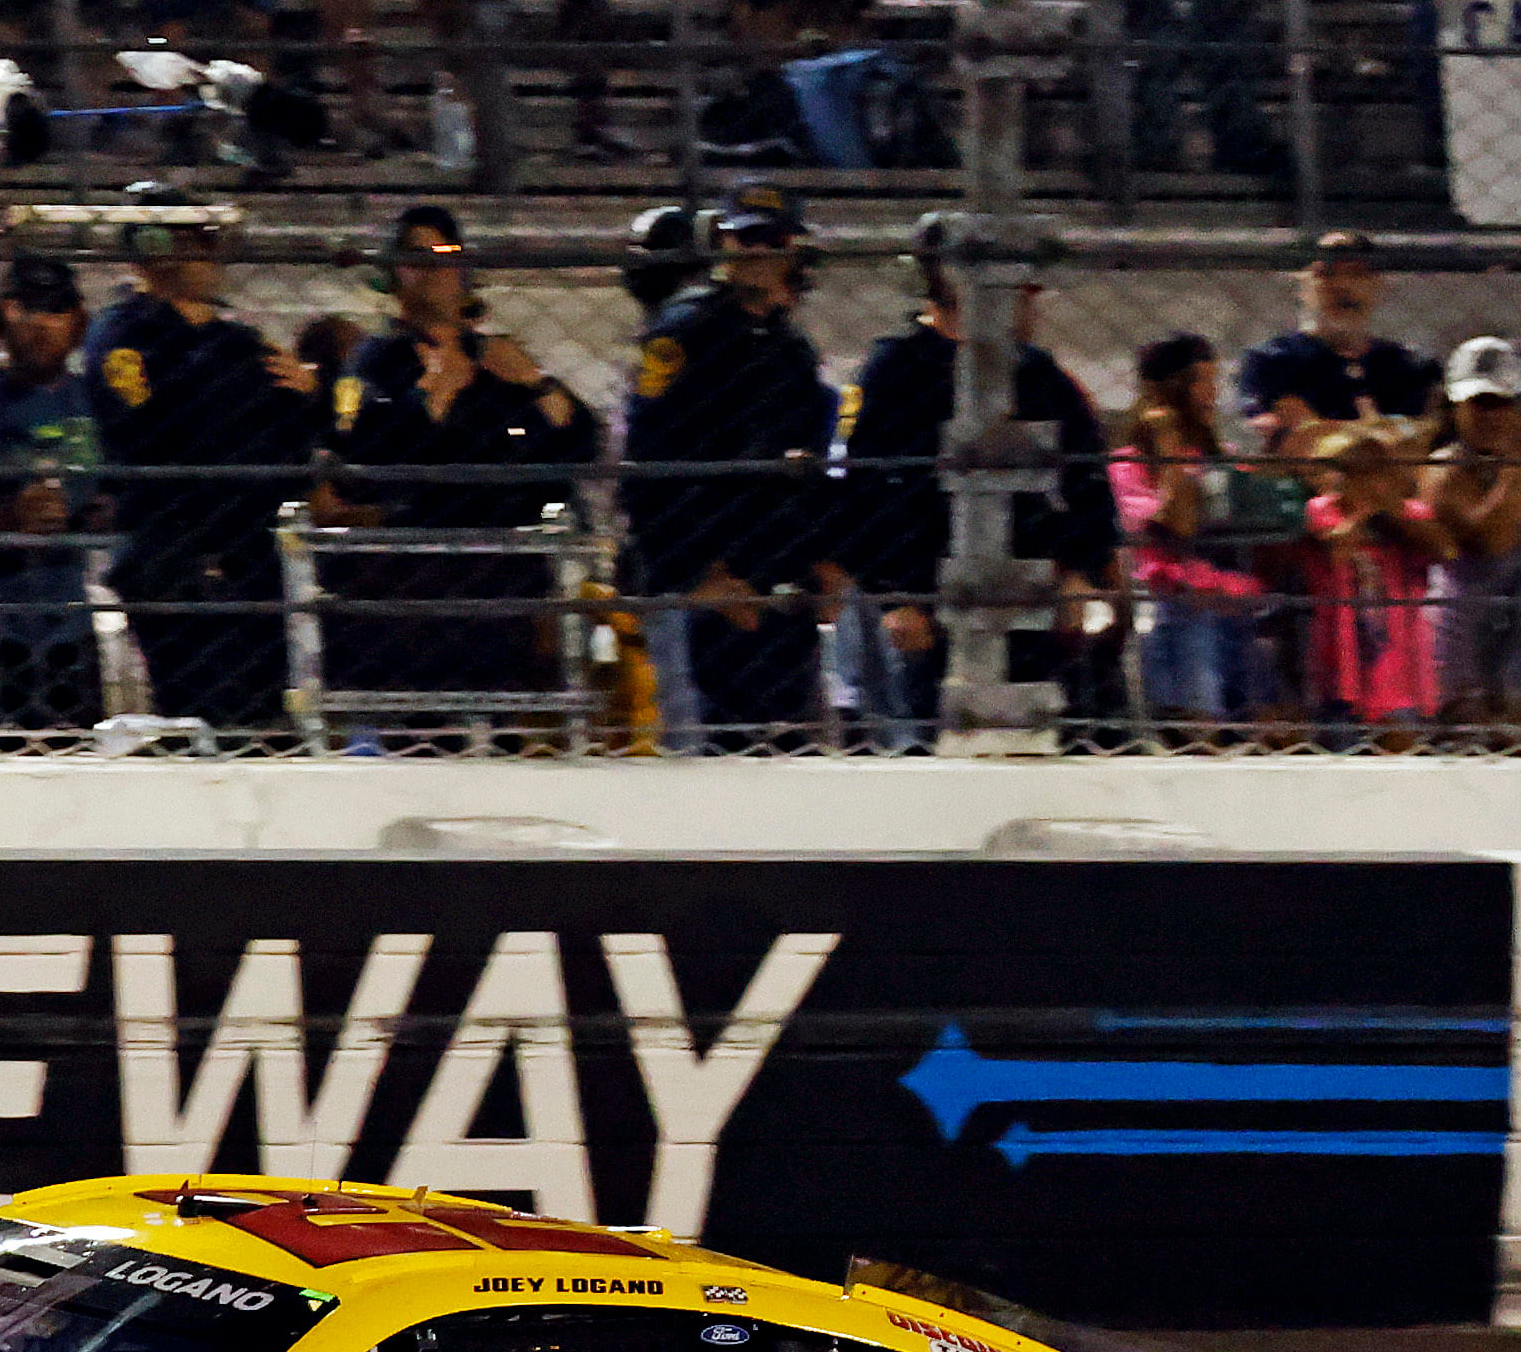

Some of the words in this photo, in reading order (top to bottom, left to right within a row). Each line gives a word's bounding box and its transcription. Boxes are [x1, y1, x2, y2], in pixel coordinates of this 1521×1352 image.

[104, 1260, 275, 1311] LOGANO
[474, 1278, 544, 1293] JOEY
[557, 1278, 664, 1295] LOGANO
